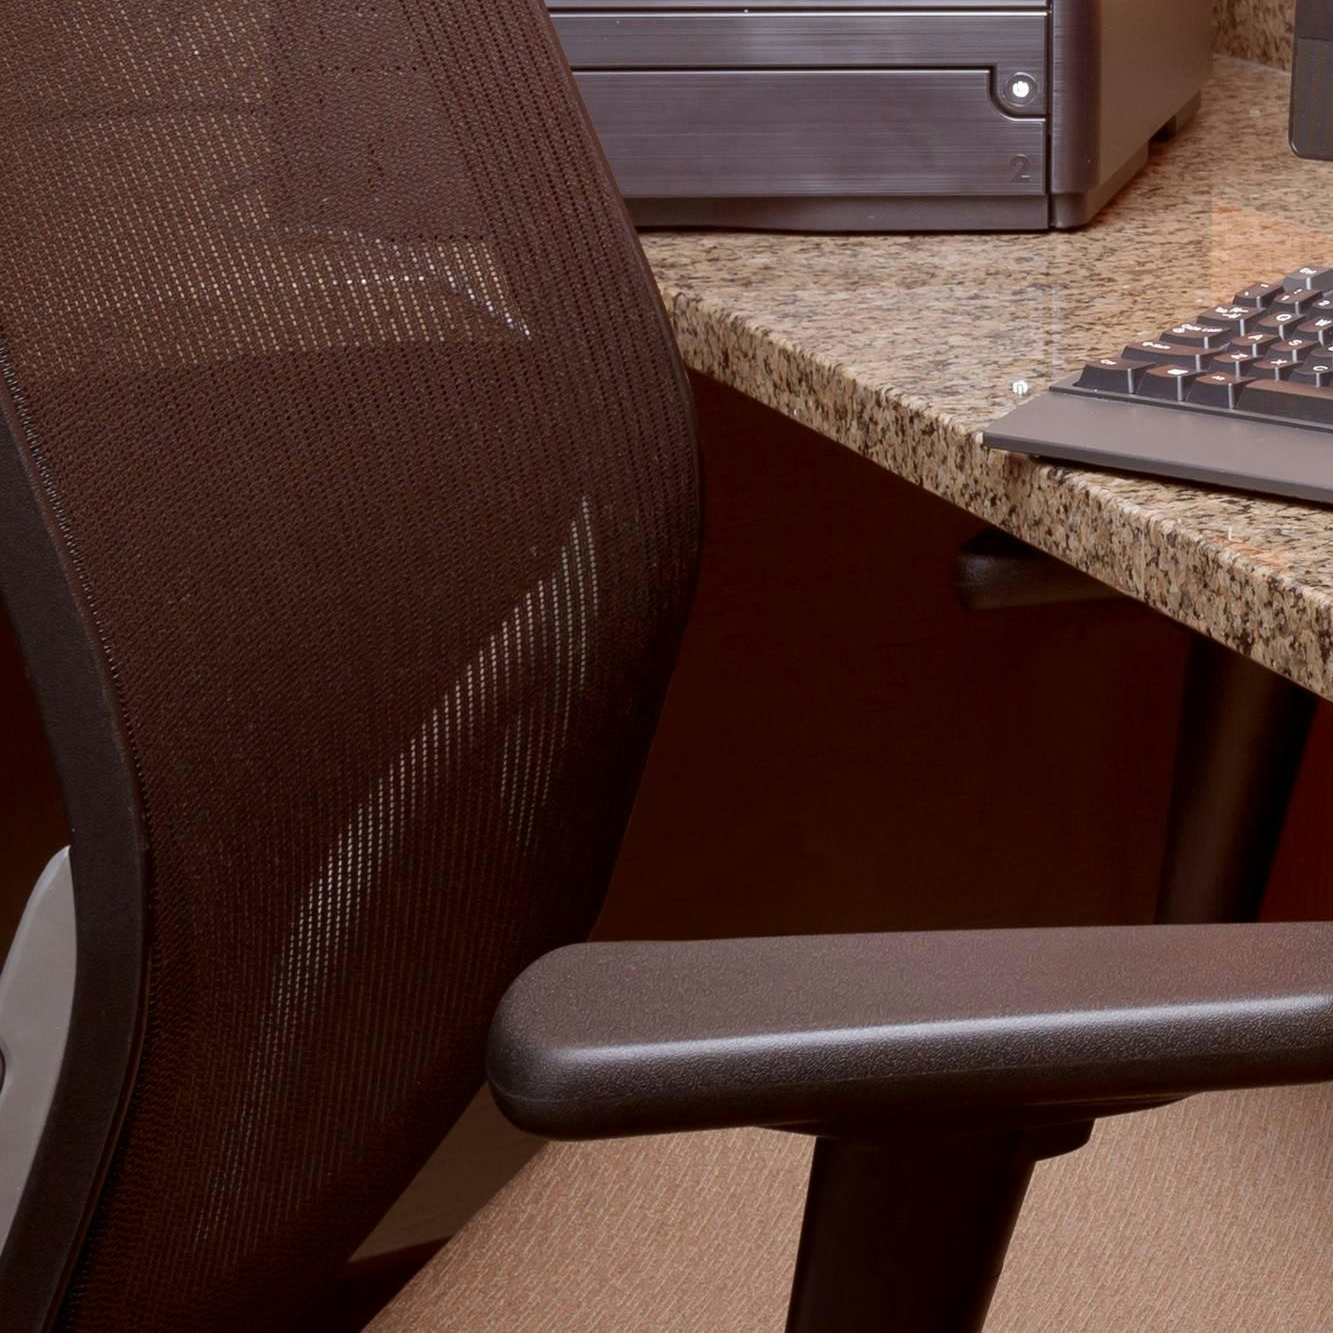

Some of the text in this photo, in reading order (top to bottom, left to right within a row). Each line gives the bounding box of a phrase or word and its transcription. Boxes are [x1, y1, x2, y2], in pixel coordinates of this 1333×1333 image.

[1009, 154, 1031, 184] 2
[1248, 333, 1264, 341] A
[1288, 339, 1303, 347] S
